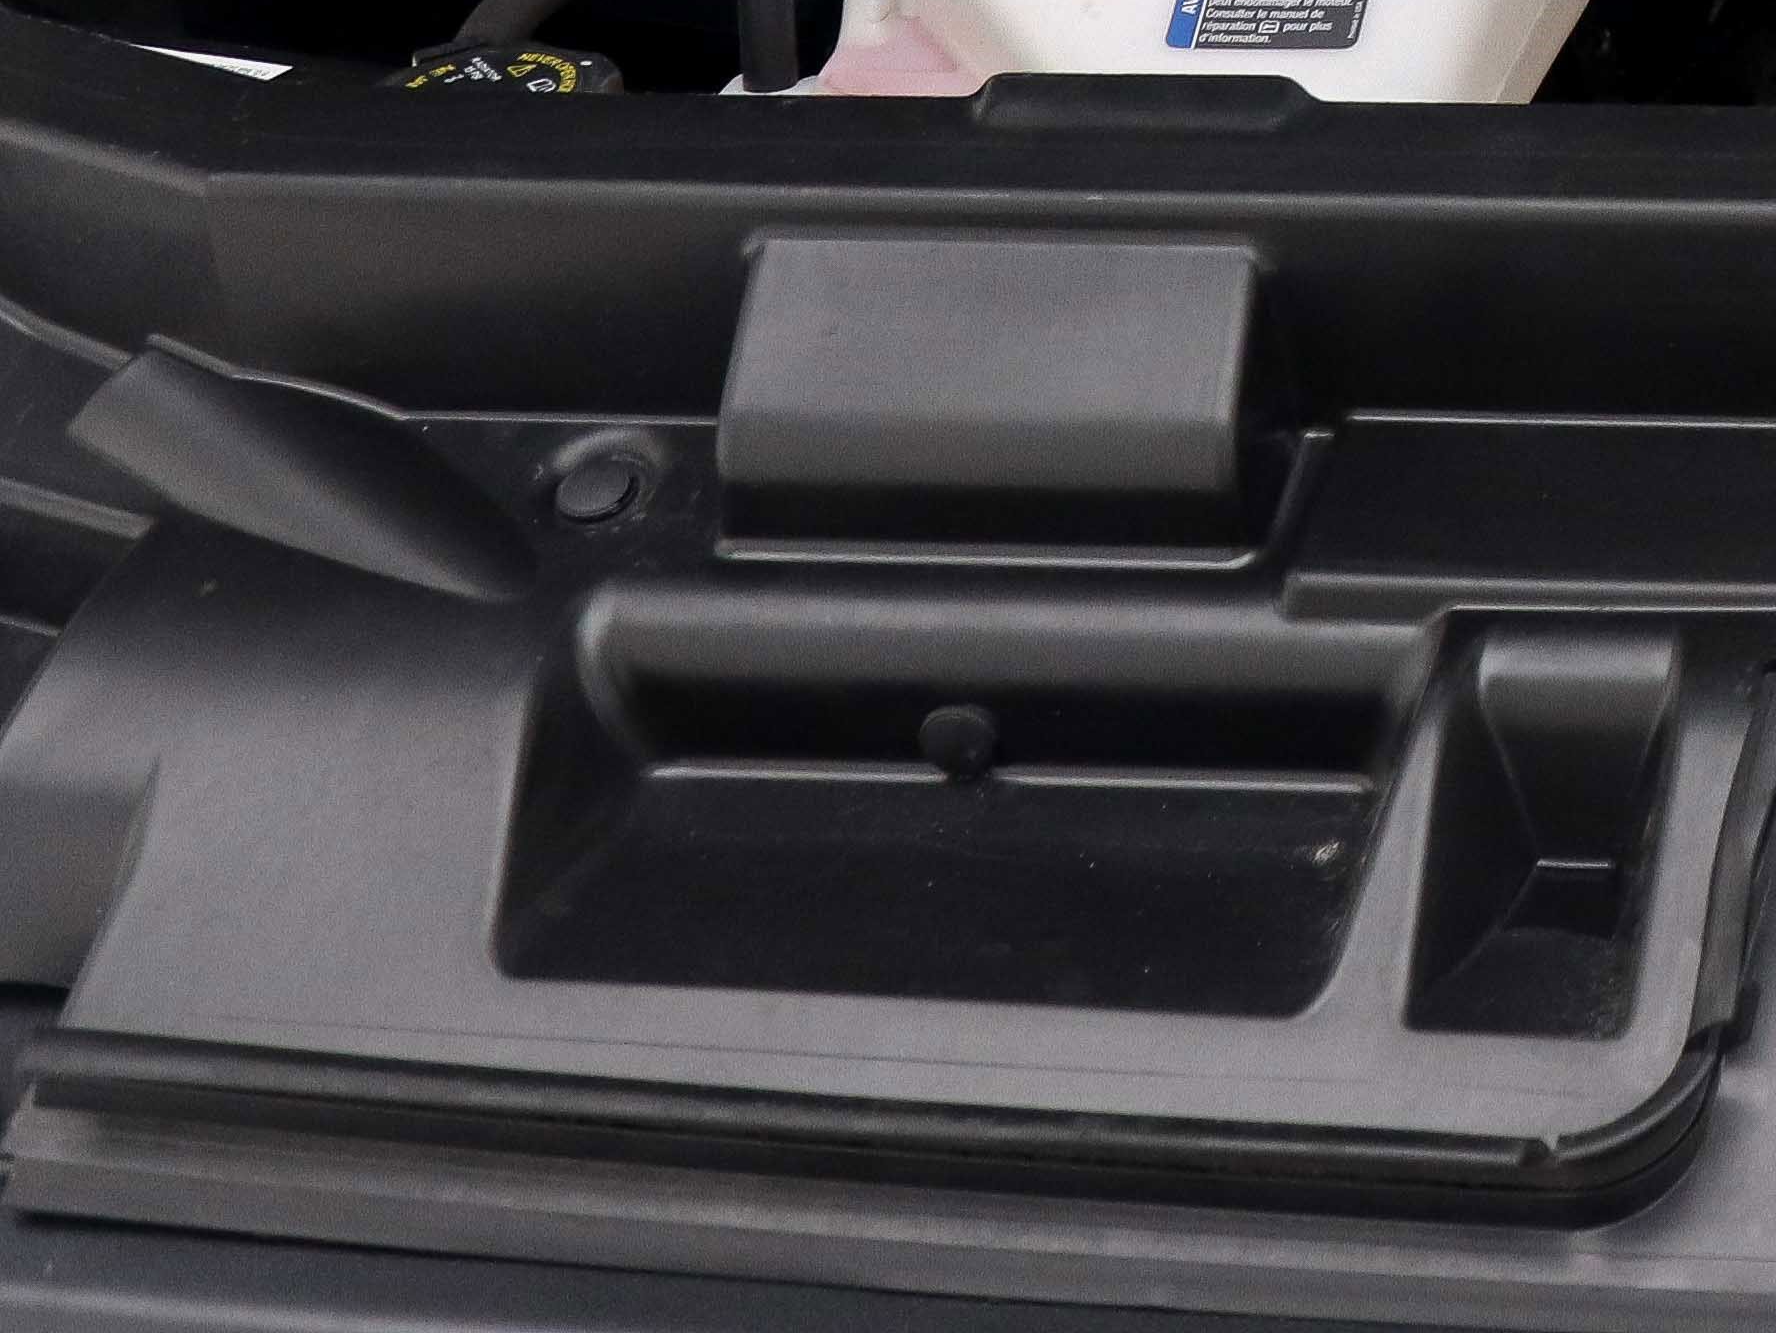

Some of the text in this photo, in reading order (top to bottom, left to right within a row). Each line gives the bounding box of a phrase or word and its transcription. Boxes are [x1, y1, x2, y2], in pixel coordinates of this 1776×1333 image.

[1205, 8, 1326, 19] Consulter le manuel de
[1282, 23, 1308, 33] pour
[1309, 21, 1334, 33] plus
